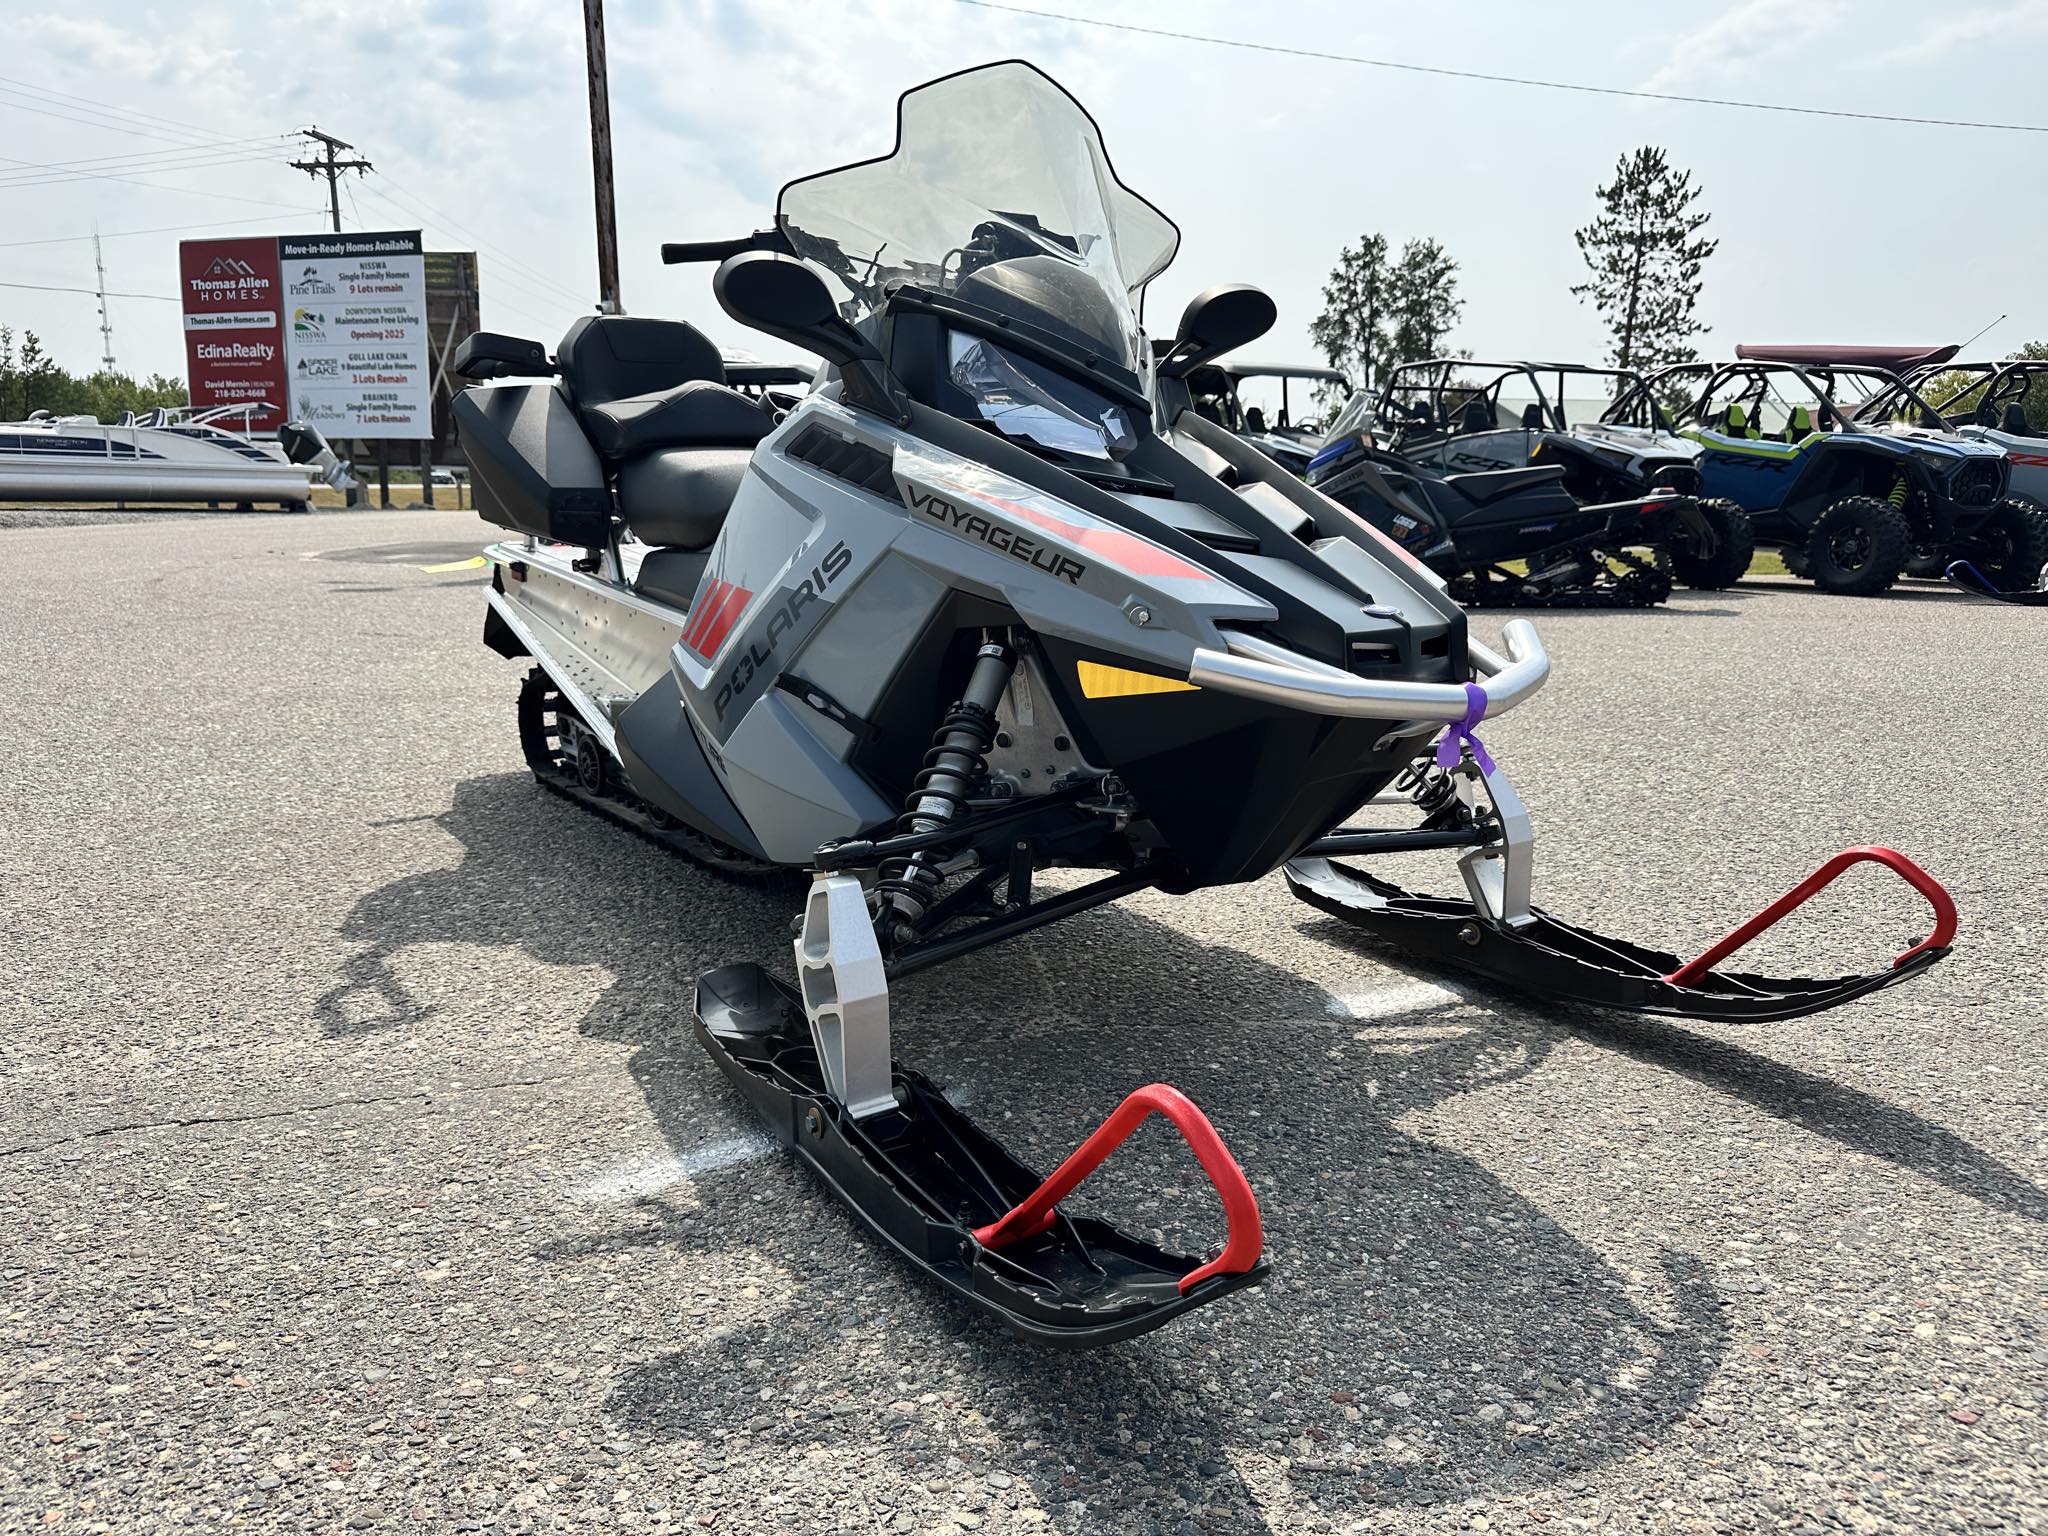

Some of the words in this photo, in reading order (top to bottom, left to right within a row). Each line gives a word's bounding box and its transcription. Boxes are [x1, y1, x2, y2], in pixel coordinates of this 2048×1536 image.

[285, 242, 345, 256] Move-in-Ready
[346, 241, 374, 252] Homes
[375, 239, 415, 251] Available
[360, 261, 387, 270] NISSWA
[338, 272, 360, 282] Single
[361, 271, 385, 282] Family
[386, 271, 410, 279] Homes
[190, 279, 237, 291] Thomas
[238, 277, 270, 289] Allen
[349, 285, 356, 294] 9
[357, 284, 374, 294] Lots
[375, 283, 404, 293] remain
[290, 284, 310, 296] Pine
[311, 283, 336, 295] Trails
[201, 289, 260, 301] HOMES
[345, 307, 382, 316] DOWNTOWN
[335, 315, 380, 325] Maintenance
[381, 315, 397, 323] Free
[397, 314, 419, 325] Living
[294, 331, 326, 339] NISSWA
[351, 330, 384, 341] Opening
[385, 329, 405, 339] 2025
[348, 353, 367, 361] GULL
[368, 352, 385, 361] LAKE
[386, 352, 408, 360] CHAIN
[307, 358, 338, 366] SPIDER
[347, 362, 377, 371] Beautiful
[378, 362, 393, 370] Lake
[394, 362, 417, 370] Homes
[308, 366, 339, 376] LAKE
[352, 375, 358, 384] 3
[359, 374, 376, 384] Lots
[377, 373, 408, 383] Remain
[204, 381, 225, 389] David
[362, 393, 399, 402] BRAINERD
[346, 403, 367, 412] Single
[368, 403, 392, 412] Family
[392, 403, 417, 411] Homes
[356, 414, 362, 423] 7
[363, 414, 380, 423] Lots
[381, 414, 411, 423] Remain
[907, 484, 1087, 585] VOYAGEUR
[713, 539, 852, 723] POLARIS
